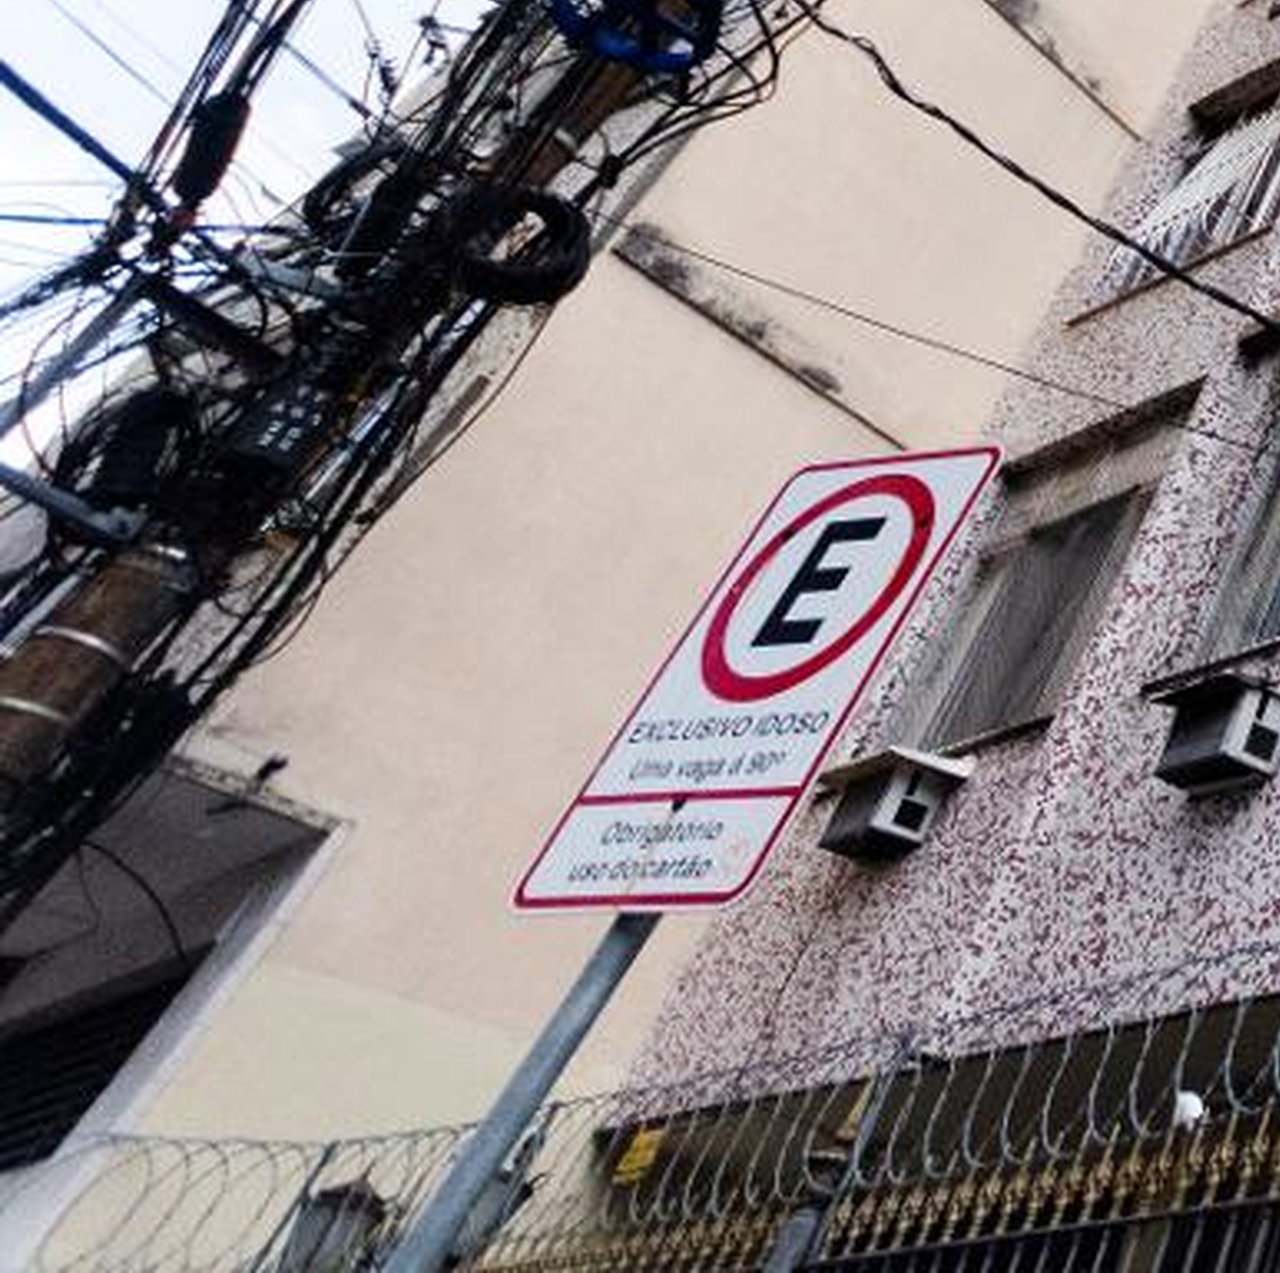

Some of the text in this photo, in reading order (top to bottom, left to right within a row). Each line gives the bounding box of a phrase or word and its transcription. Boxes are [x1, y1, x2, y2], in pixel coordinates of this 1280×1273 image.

[751, 517, 887, 647] E
[628, 712, 830, 744] EXCLUSIVO IDOSO
[677, 758, 727, 783] vaga
[602, 821, 723, 848] Obrigatório
[568, 862, 608, 881] uso
[639, 854, 713, 878] cartão
